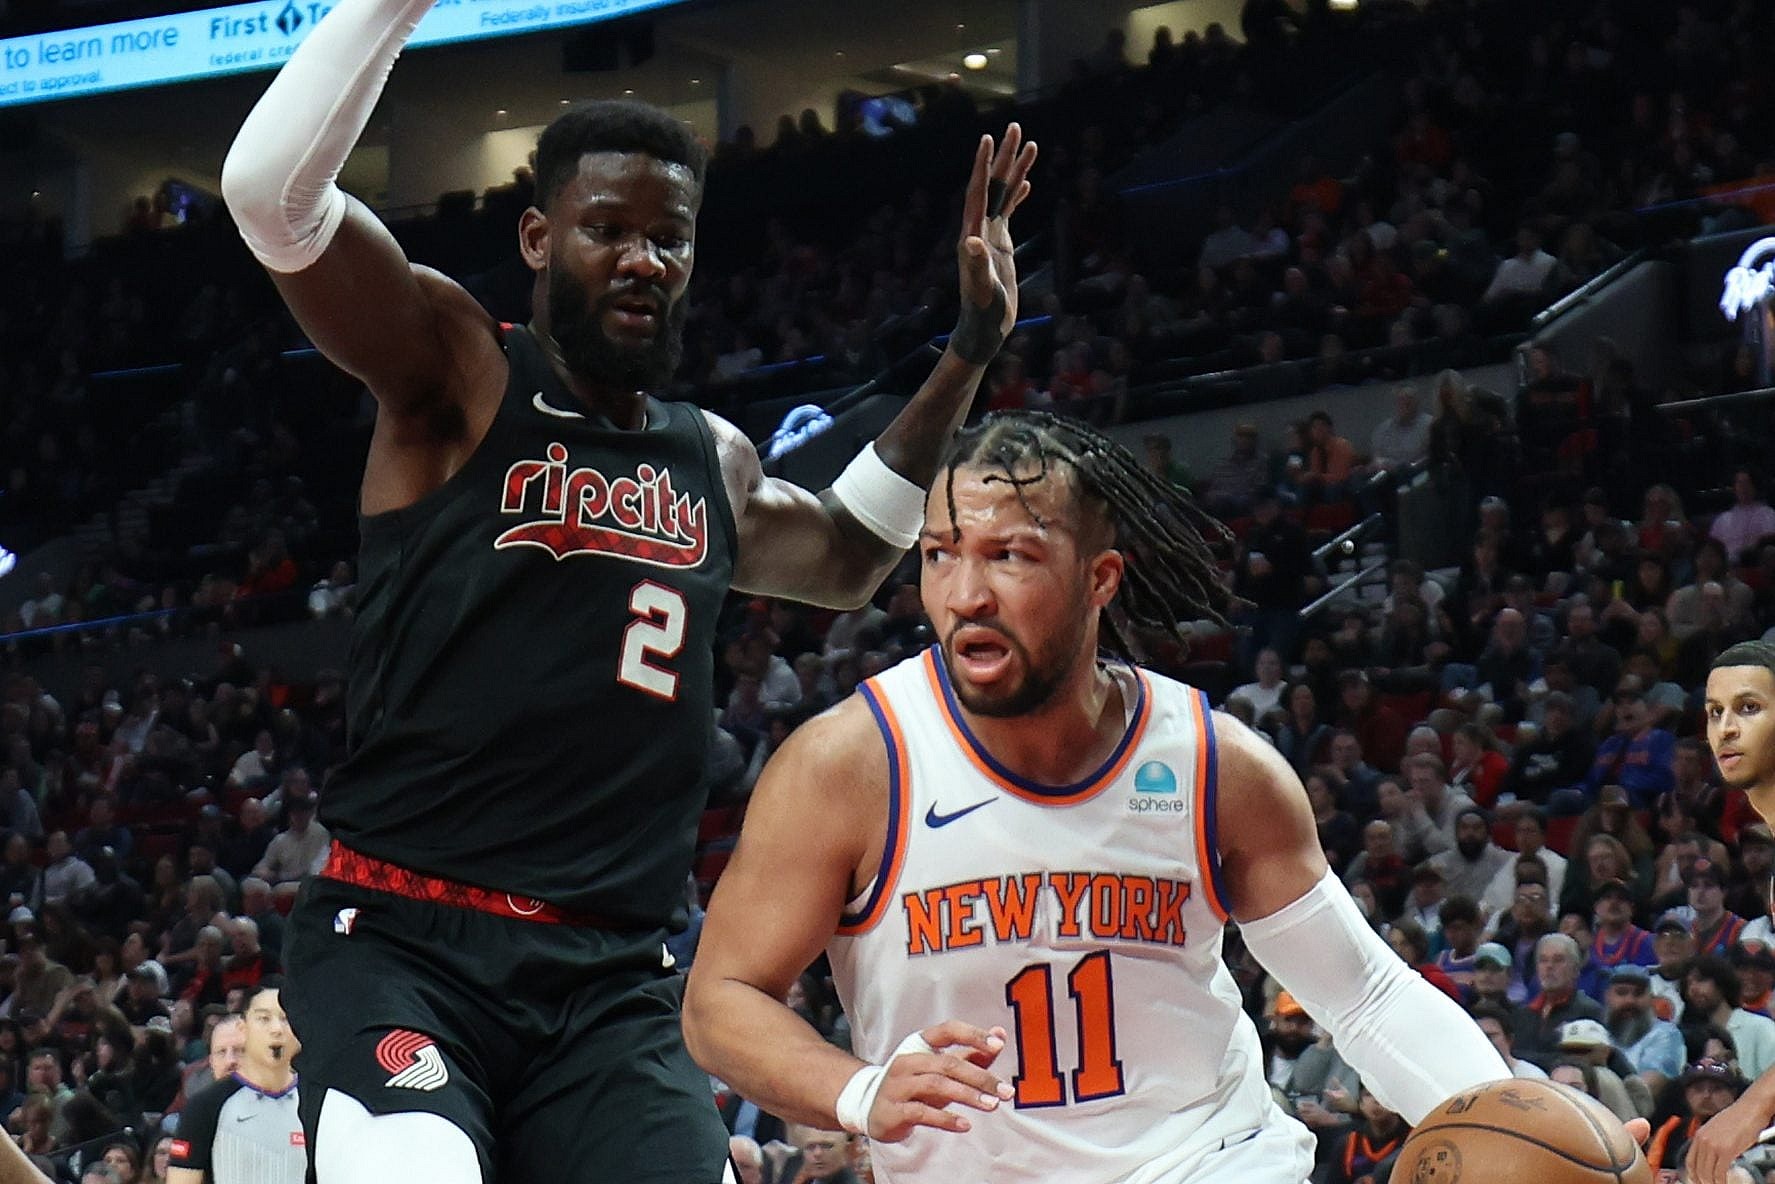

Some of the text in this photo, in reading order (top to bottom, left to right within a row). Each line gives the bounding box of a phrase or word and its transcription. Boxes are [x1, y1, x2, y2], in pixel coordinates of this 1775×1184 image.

[5, 27, 179, 69] to learn more
[210, 12, 268, 39] First
[617, 578, 688, 702] 2
[1129, 796, 1183, 813] sphere
[902, 871, 1192, 958] NEW YORK
[1005, 949, 1127, 1110] 11
